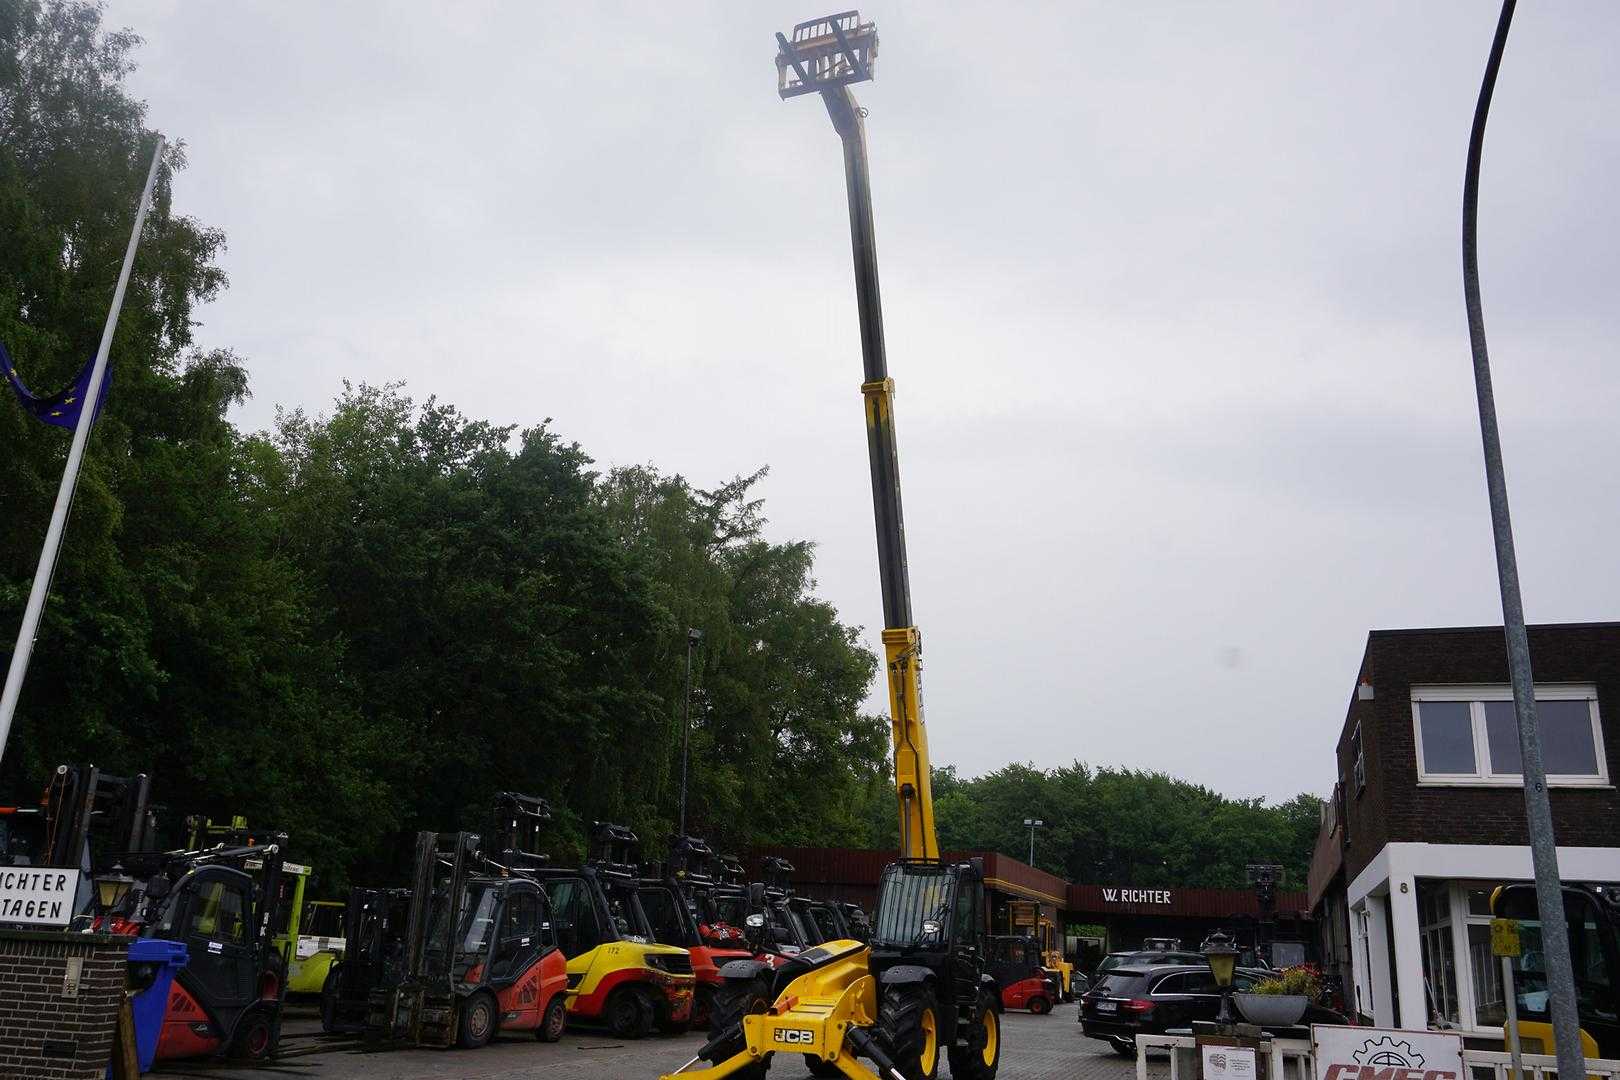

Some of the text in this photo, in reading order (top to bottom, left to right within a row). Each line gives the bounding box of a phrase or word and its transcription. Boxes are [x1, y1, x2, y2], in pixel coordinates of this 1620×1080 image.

[1102, 888, 1171, 904] W. RICHTER
[1400, 882, 1408, 894] 8
[2, 899, 61, 918] TAGEN
[775, 1028, 814, 1044] JCB
